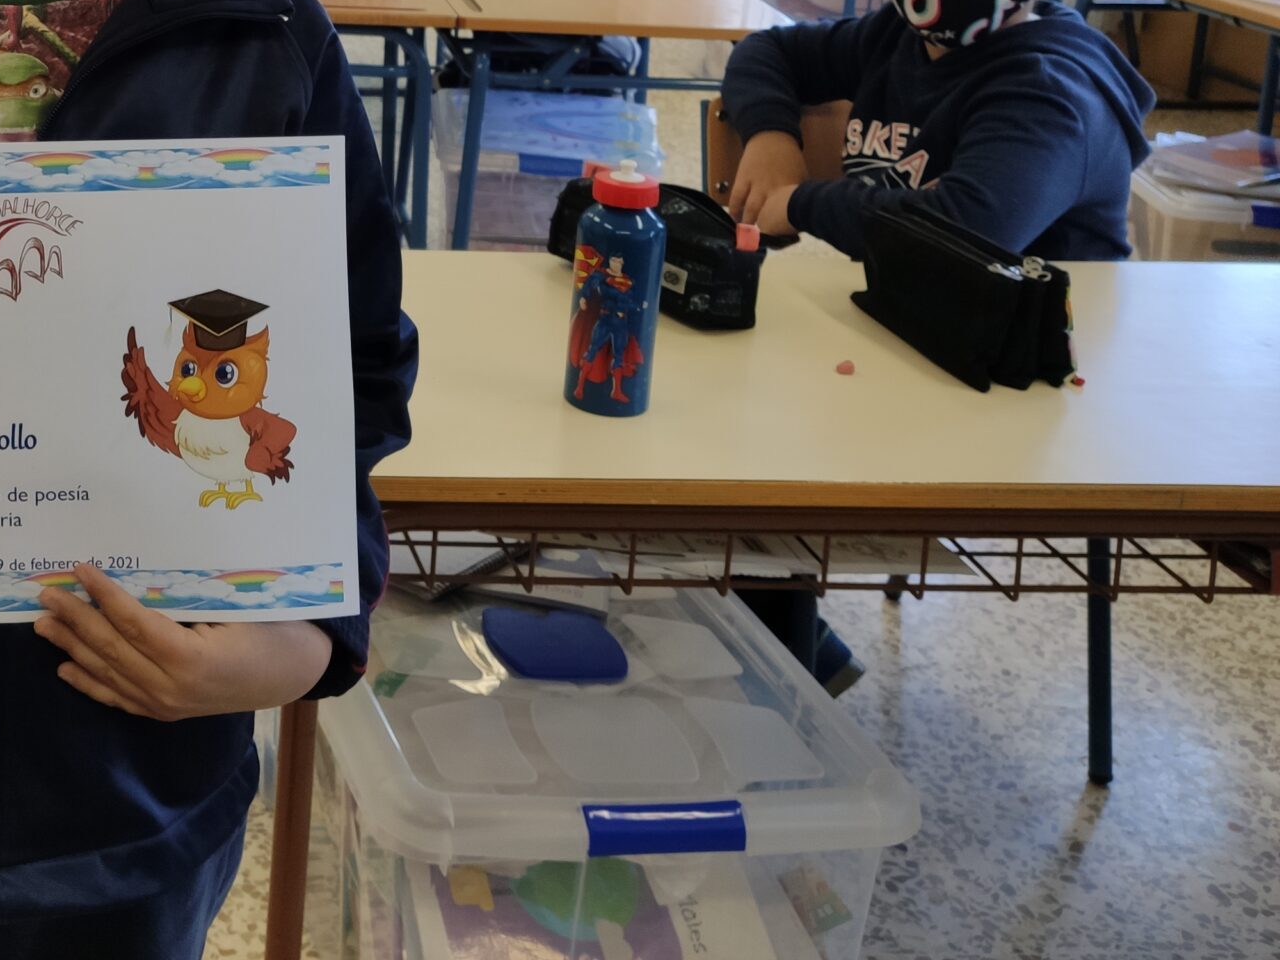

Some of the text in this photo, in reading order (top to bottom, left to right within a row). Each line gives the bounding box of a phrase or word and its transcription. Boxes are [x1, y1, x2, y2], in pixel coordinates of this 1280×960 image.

[7, 486, 28, 503] de
[35, 484, 90, 506] poesía
[9, 557, 26, 571] de
[87, 556, 103, 569] de
[108, 556, 140, 570] 2021
